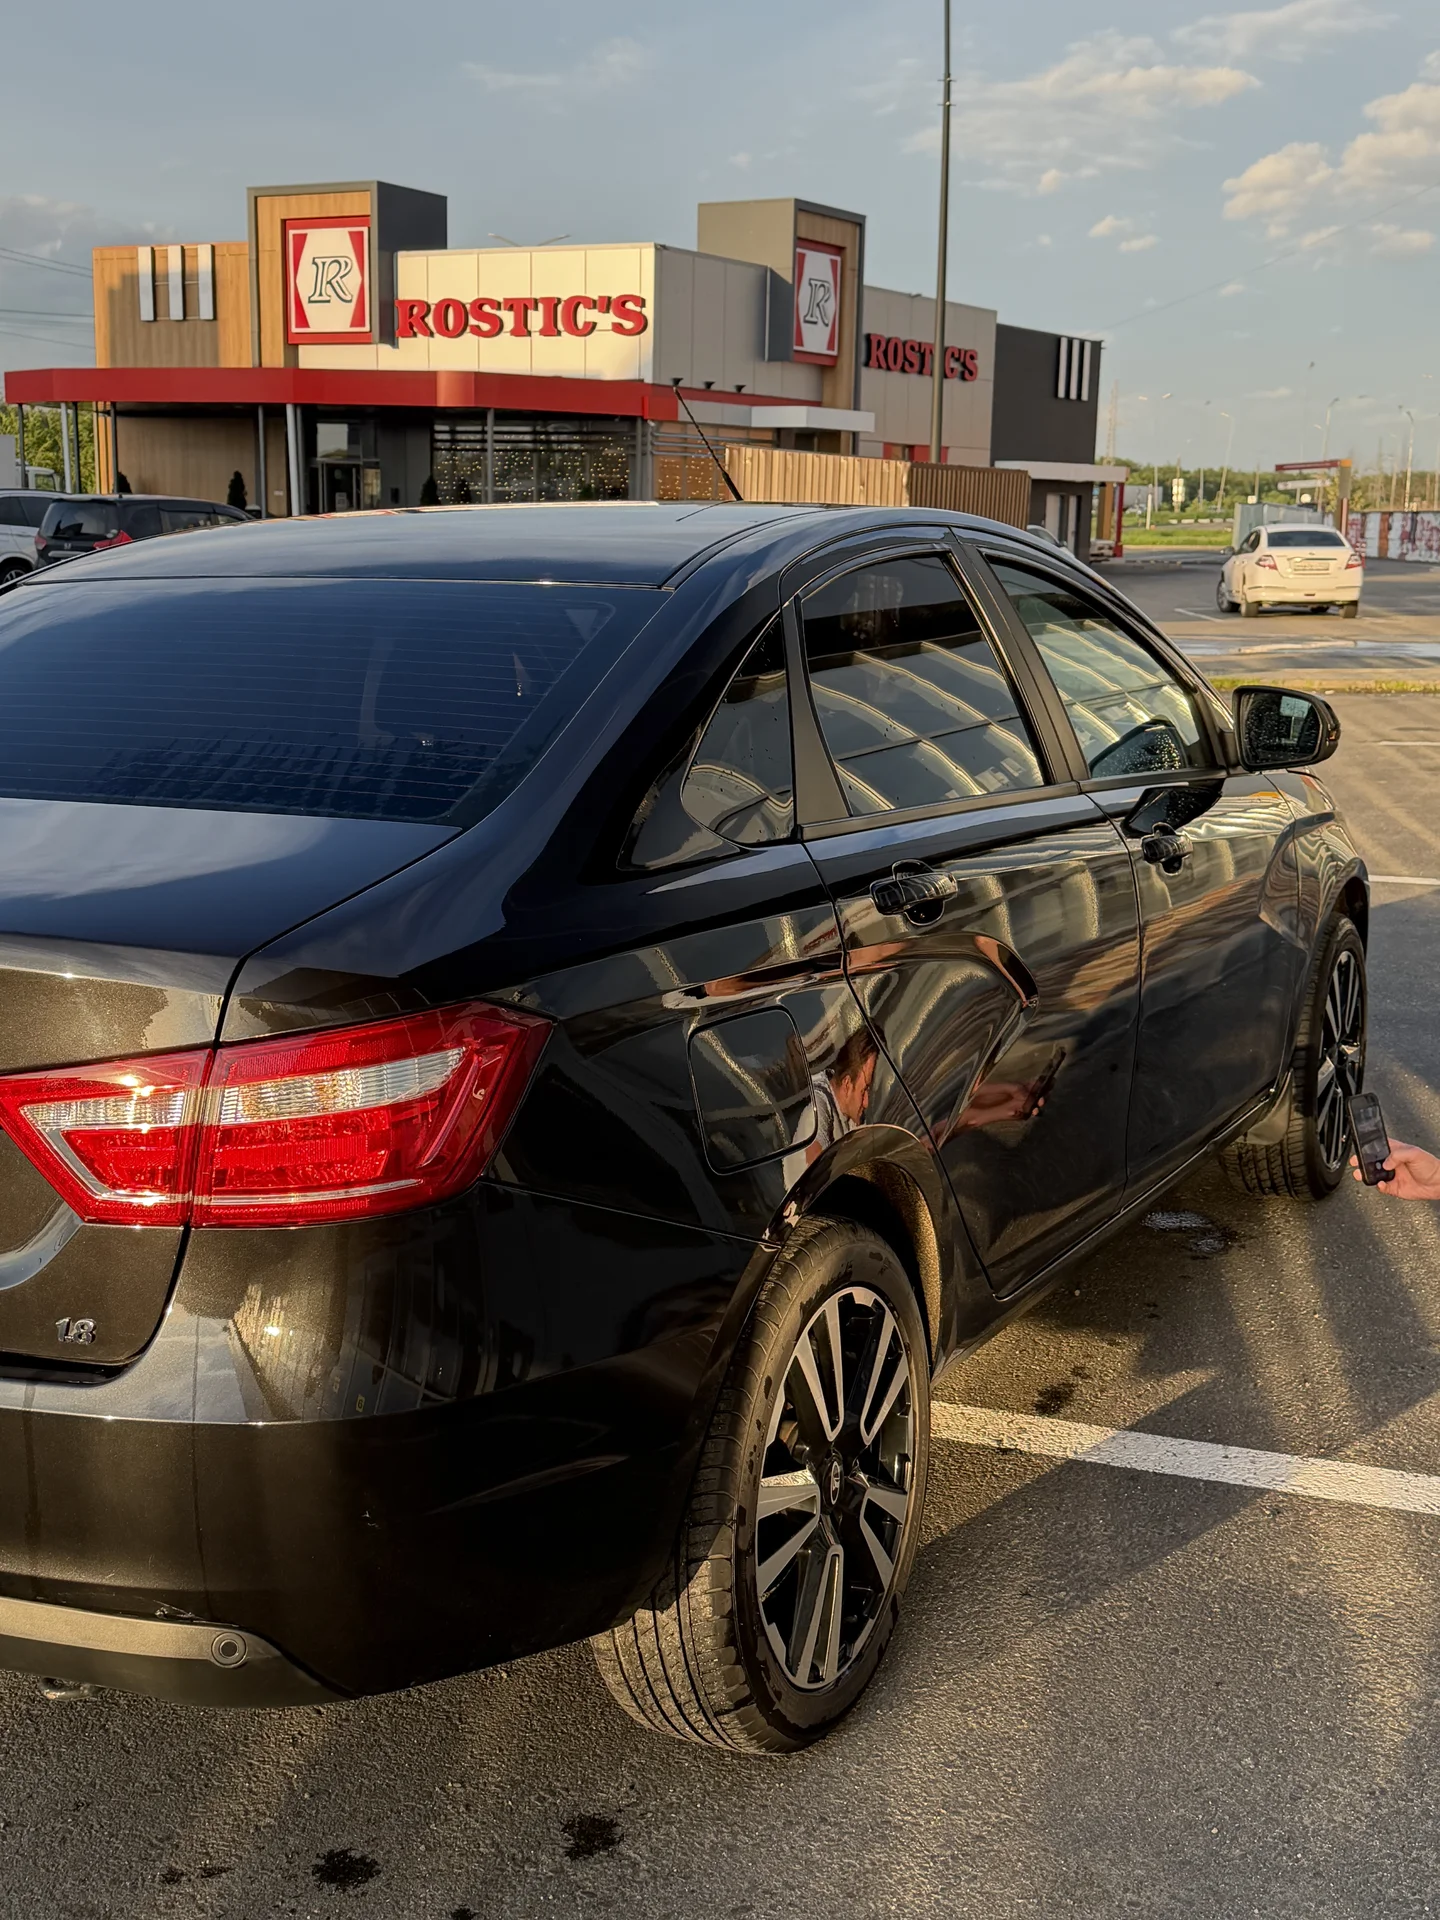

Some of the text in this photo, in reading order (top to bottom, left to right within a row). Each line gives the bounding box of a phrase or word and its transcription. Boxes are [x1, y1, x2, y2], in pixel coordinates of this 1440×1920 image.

[308, 256, 353, 304] R
[804, 278, 831, 327] R
[395, 294, 648, 338] ROSTIC'S
[865, 333, 978, 382] ROSTC'S
